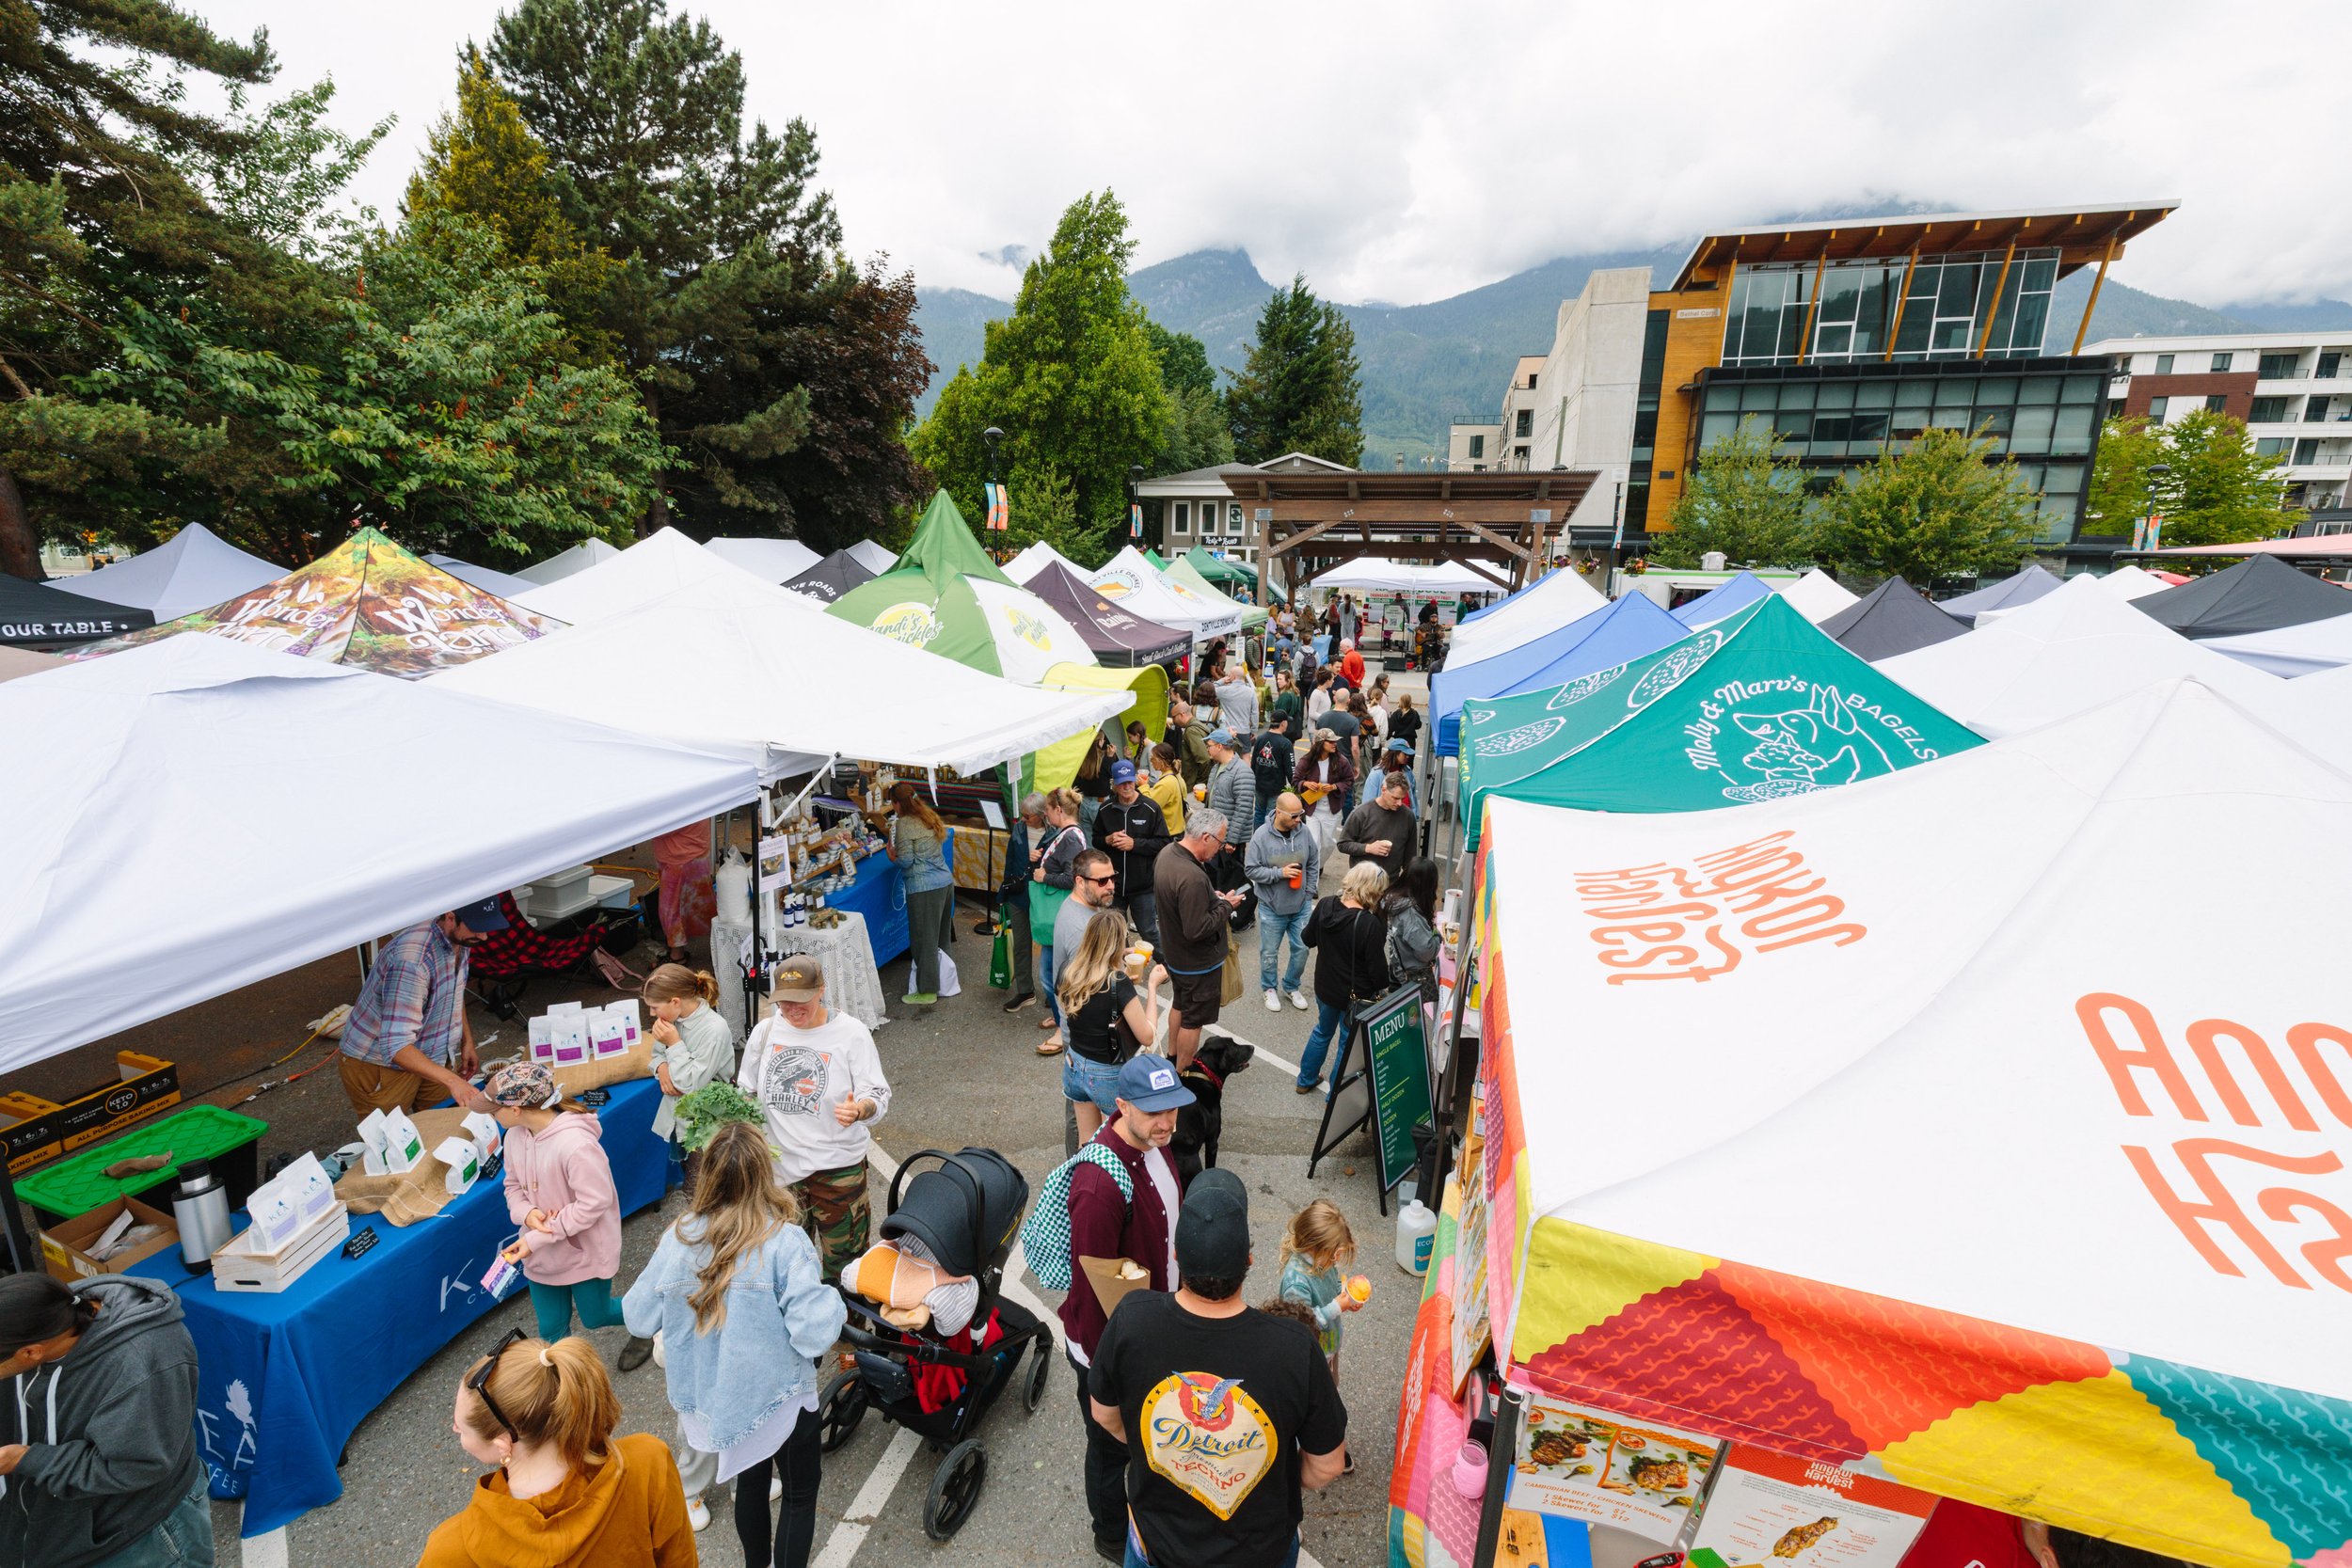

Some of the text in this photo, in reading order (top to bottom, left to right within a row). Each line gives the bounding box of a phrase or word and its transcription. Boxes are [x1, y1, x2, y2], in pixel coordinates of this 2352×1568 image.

[808, 580, 836, 597] ROADS
[230, 589, 340, 628] Wonder
[376, 594, 505, 633] Wonder
[1, 621, 113, 637] OUR TABLE
[1683, 675, 1939, 770] Molly & Marv's BAGELS
[1375, 1012, 1406, 1046] MENU
[1375, 1037, 1403, 1060] SINGLE BAGEL
[109, 1092, 134, 1107] KETO
[116, 1101, 129, 1110] 1.0
[771, 1093, 810, 1107] HARLEY
[774, 1102, 803, 1113] DAVIDSON
[1381, 1088, 1406, 1111] HALF DOZEN
[77, 1099, 170, 1143] ALL PURPOSE BAKING MIX
[84, 1113, 97, 1121] SLICE
[1383, 1113, 1398, 1127] DOZEN
[32, 1149, 49, 1161] MIX
[302, 1180, 323, 1196] KEA
[268, 1205, 290, 1222] KEA
[198, 1408, 257, 1471] EA
[1153, 1417, 1264, 1453] Detroit
[1180, 1451, 1235, 1477] Premium
[1171, 1459, 1247, 1490] TECHNO
[1804, 1468, 1855, 1490] Harvest
[1524, 1481, 1571, 1494] CAMBODIAN
[1597, 1496, 1634, 1509] CHICKEN
[1633, 1506, 1673, 1524] SKEWERS
[1550, 1500, 1588, 1513] Skewers
[1551, 1494, 1585, 1505] Skewer
